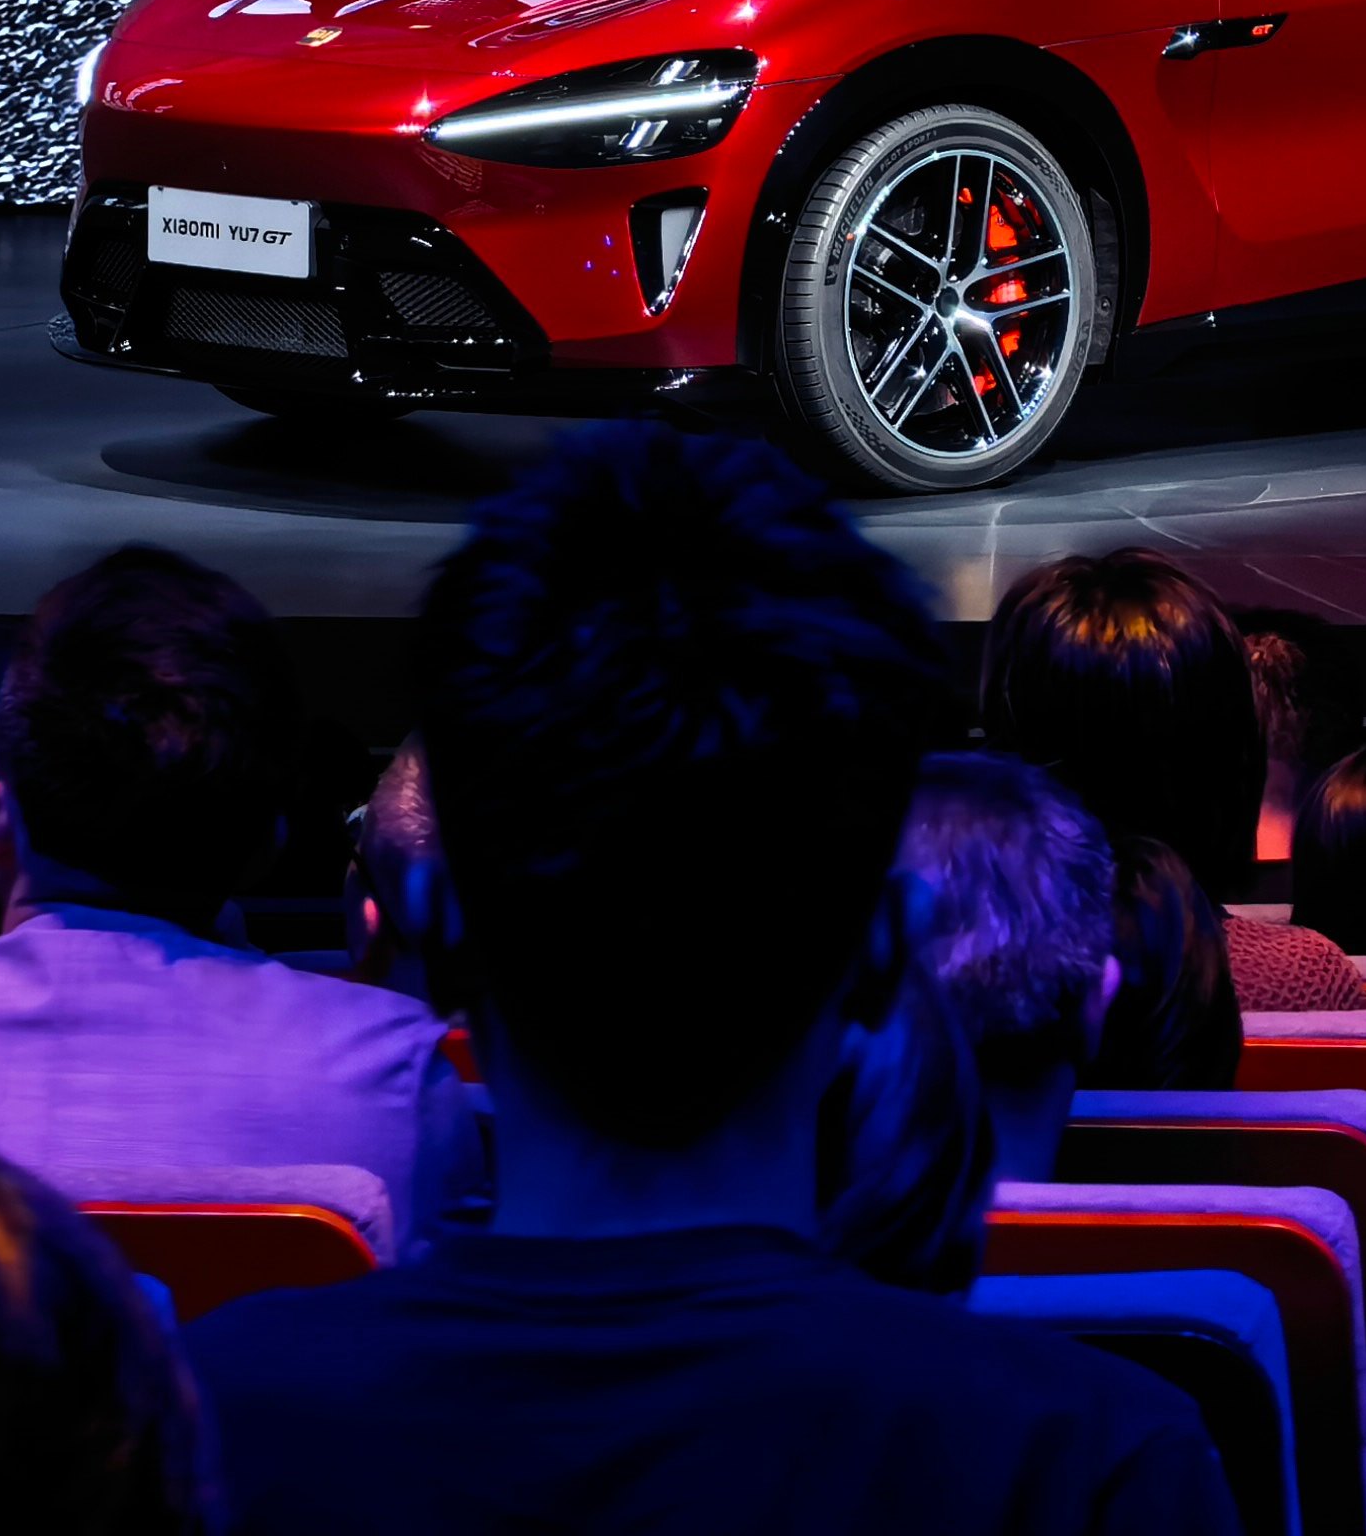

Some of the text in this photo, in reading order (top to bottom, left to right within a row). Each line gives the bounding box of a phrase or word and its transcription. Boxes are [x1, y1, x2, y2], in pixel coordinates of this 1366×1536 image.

[1252, 23, 1274, 35] GT
[831, 175, 874, 260] MICHELIN
[228, 225, 260, 243] YU7
[262, 230, 293, 245] GT
